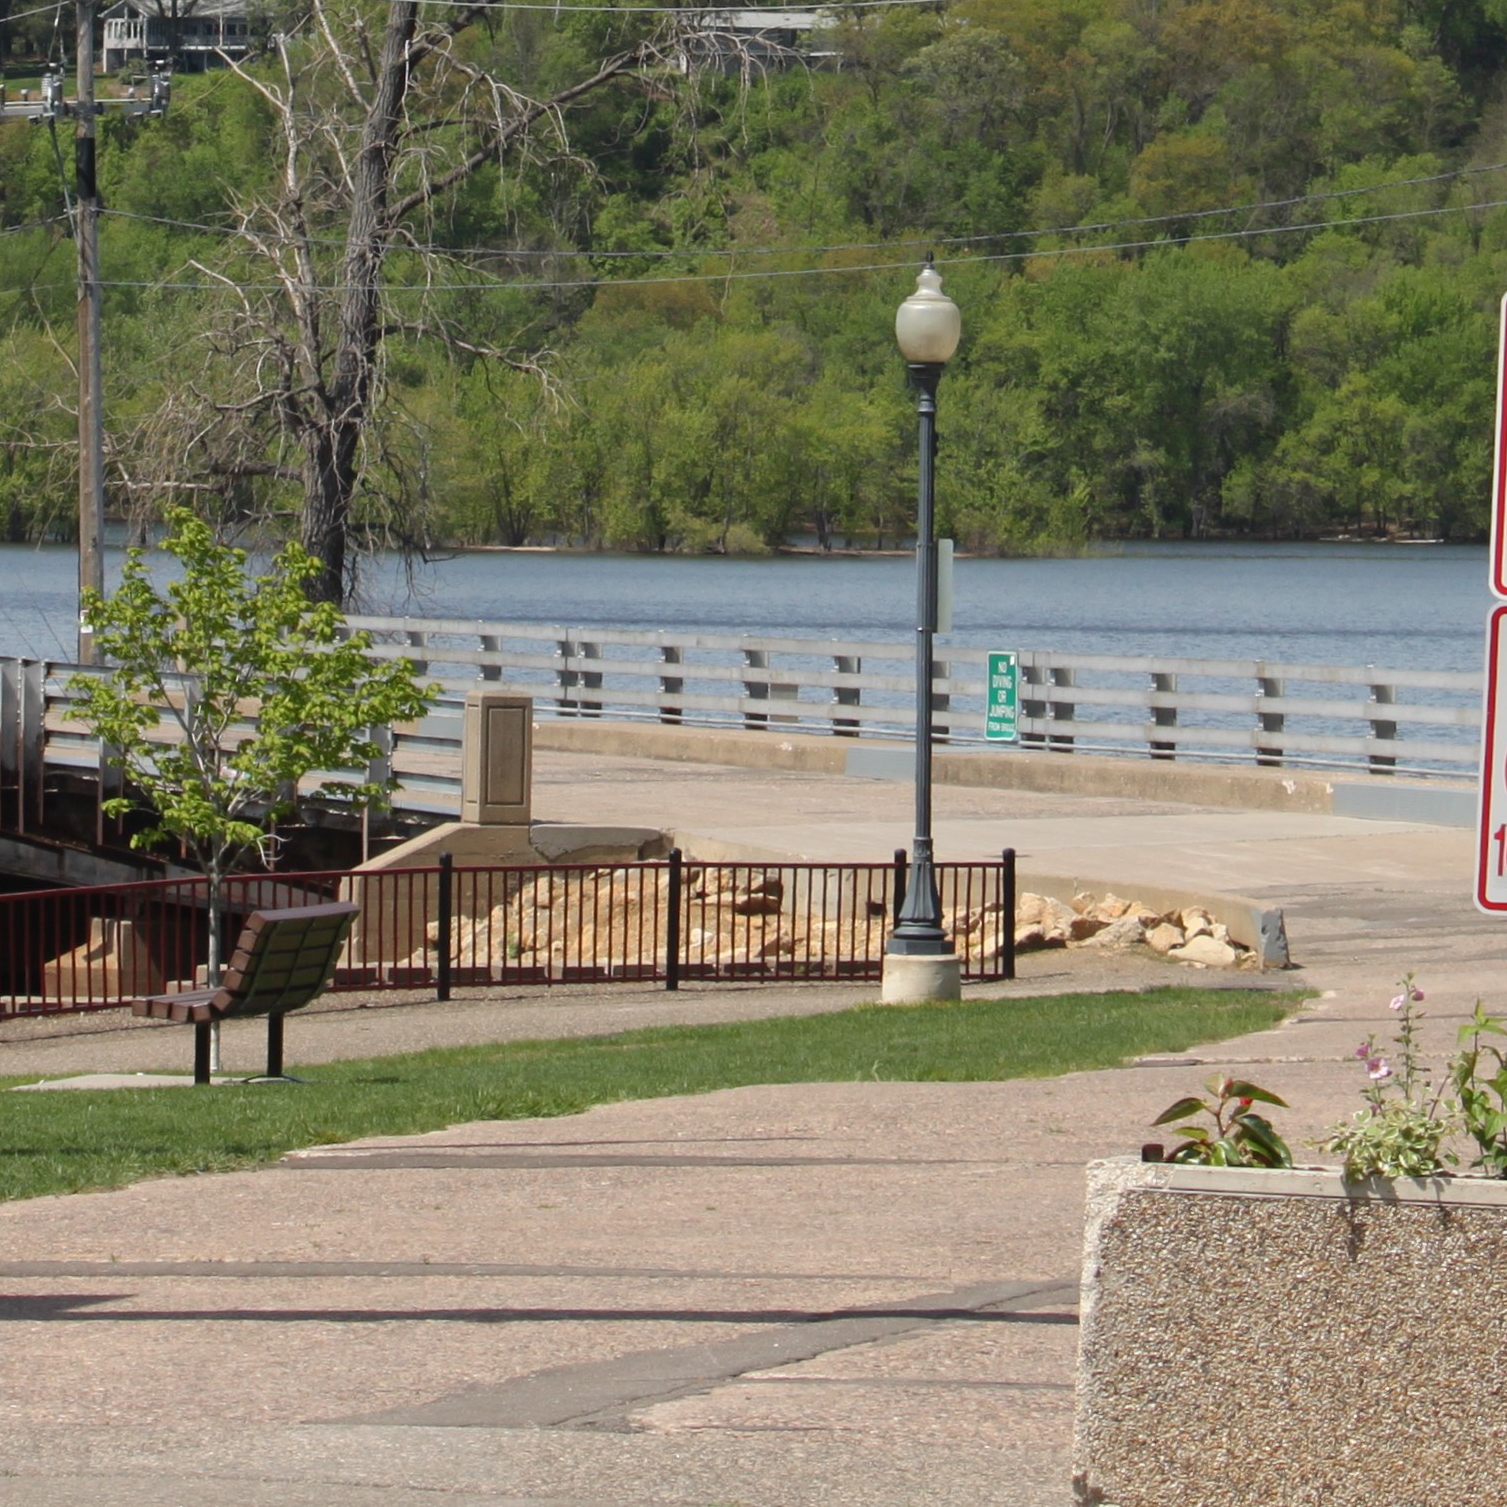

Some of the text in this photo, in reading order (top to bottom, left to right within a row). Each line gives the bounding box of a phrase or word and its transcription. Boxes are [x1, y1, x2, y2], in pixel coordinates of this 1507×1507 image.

[997, 661, 1007, 674] NO
[992, 674, 1012, 689] DIVING
[997, 690, 1007, 703] OR
[989, 705, 1014, 719] JUMPING
